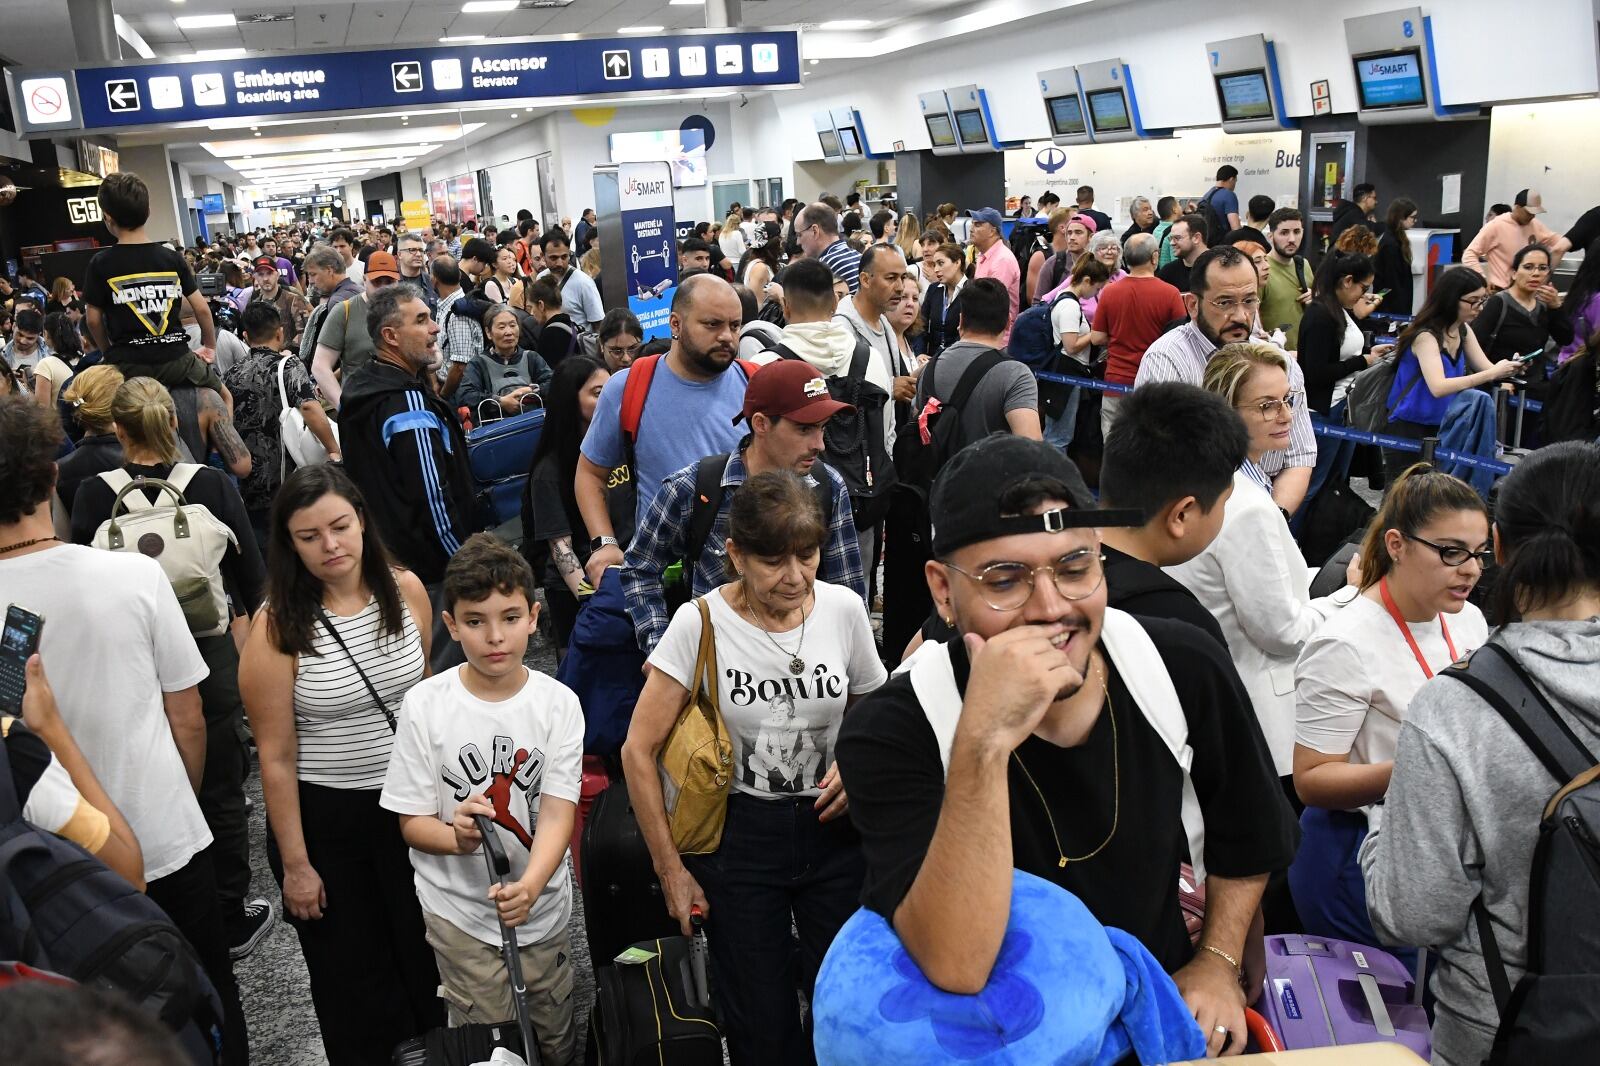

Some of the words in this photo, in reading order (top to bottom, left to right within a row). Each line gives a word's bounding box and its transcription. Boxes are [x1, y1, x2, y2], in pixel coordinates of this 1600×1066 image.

[1403, 20, 1414, 38] 8
[471, 57, 548, 73] Ascensor
[1210, 51, 1219, 66] 7
[233, 68, 326, 88] Embarque
[472, 76, 519, 88] Elevator
[1040, 79, 1048, 92] 5
[236, 89, 292, 103] Boarding
[293, 88, 320, 99] area
[633, 219, 657, 231] MANTENÉ
[656, 219, 663, 227] LA
[637, 227, 661, 239] DISTANCIA
[112, 284, 183, 305] MONSTER
[136, 298, 169, 315] JAM
[726, 663, 843, 707] Bowie
[441, 735, 545, 803] JORD
